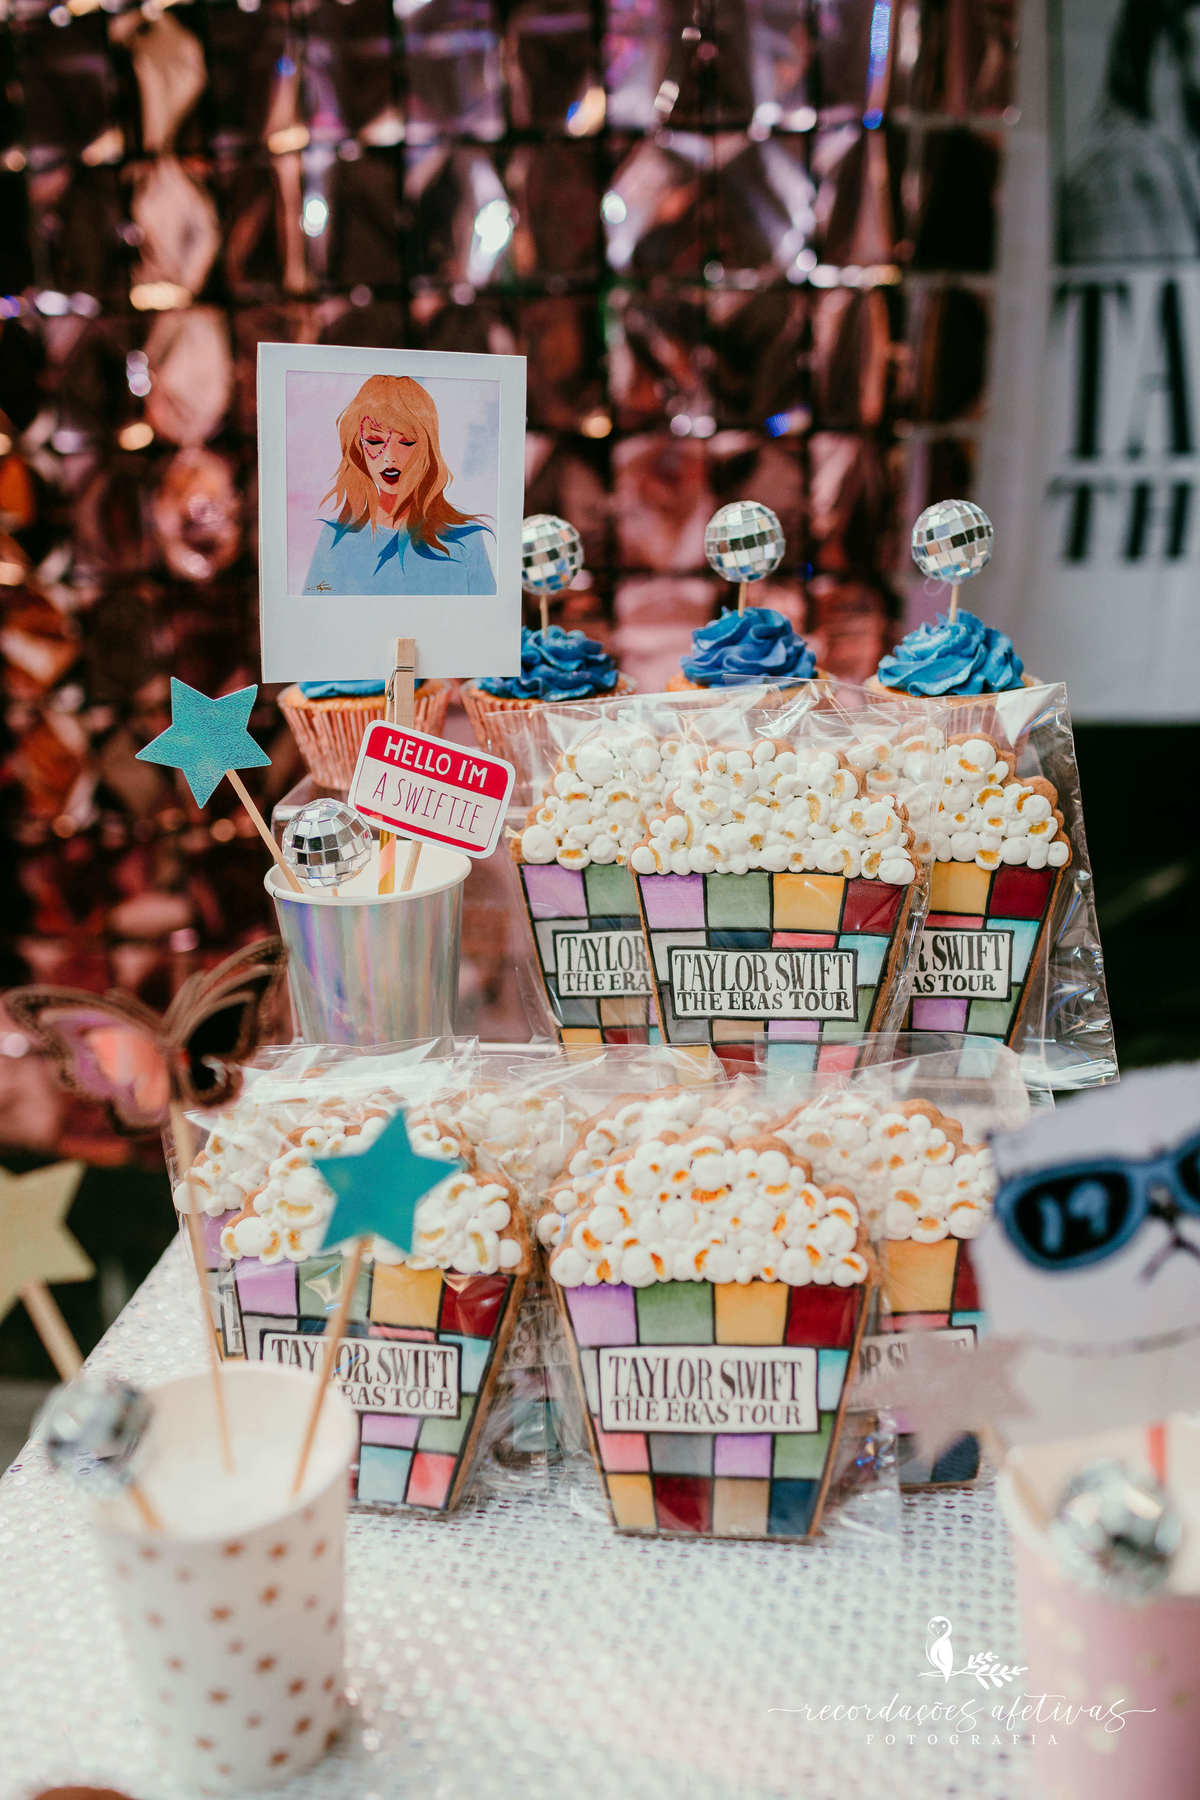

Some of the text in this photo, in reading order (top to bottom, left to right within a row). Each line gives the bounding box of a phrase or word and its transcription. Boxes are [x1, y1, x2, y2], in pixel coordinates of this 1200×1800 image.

[383, 735, 488, 789] HELLO I'M
[372, 772, 484, 834] A SWIFTIE
[560, 936, 649, 972] TAYLOR
[932, 934, 1005, 972] SWIFT
[562, 971, 653, 992] THE ERA
[674, 952, 850, 992] TAYLOR SWIFT
[938, 974, 997, 993] TOUR
[677, 991, 852, 1012] THE ERAS TOUR
[271, 1339, 454, 1389] TAYOR SWIFT
[608, 1356, 802, 1402] TAYLOR SWIFT
[337, 1384, 455, 1410] RAS TOUR
[610, 1399, 801, 1425] THE ERAS TOUR
